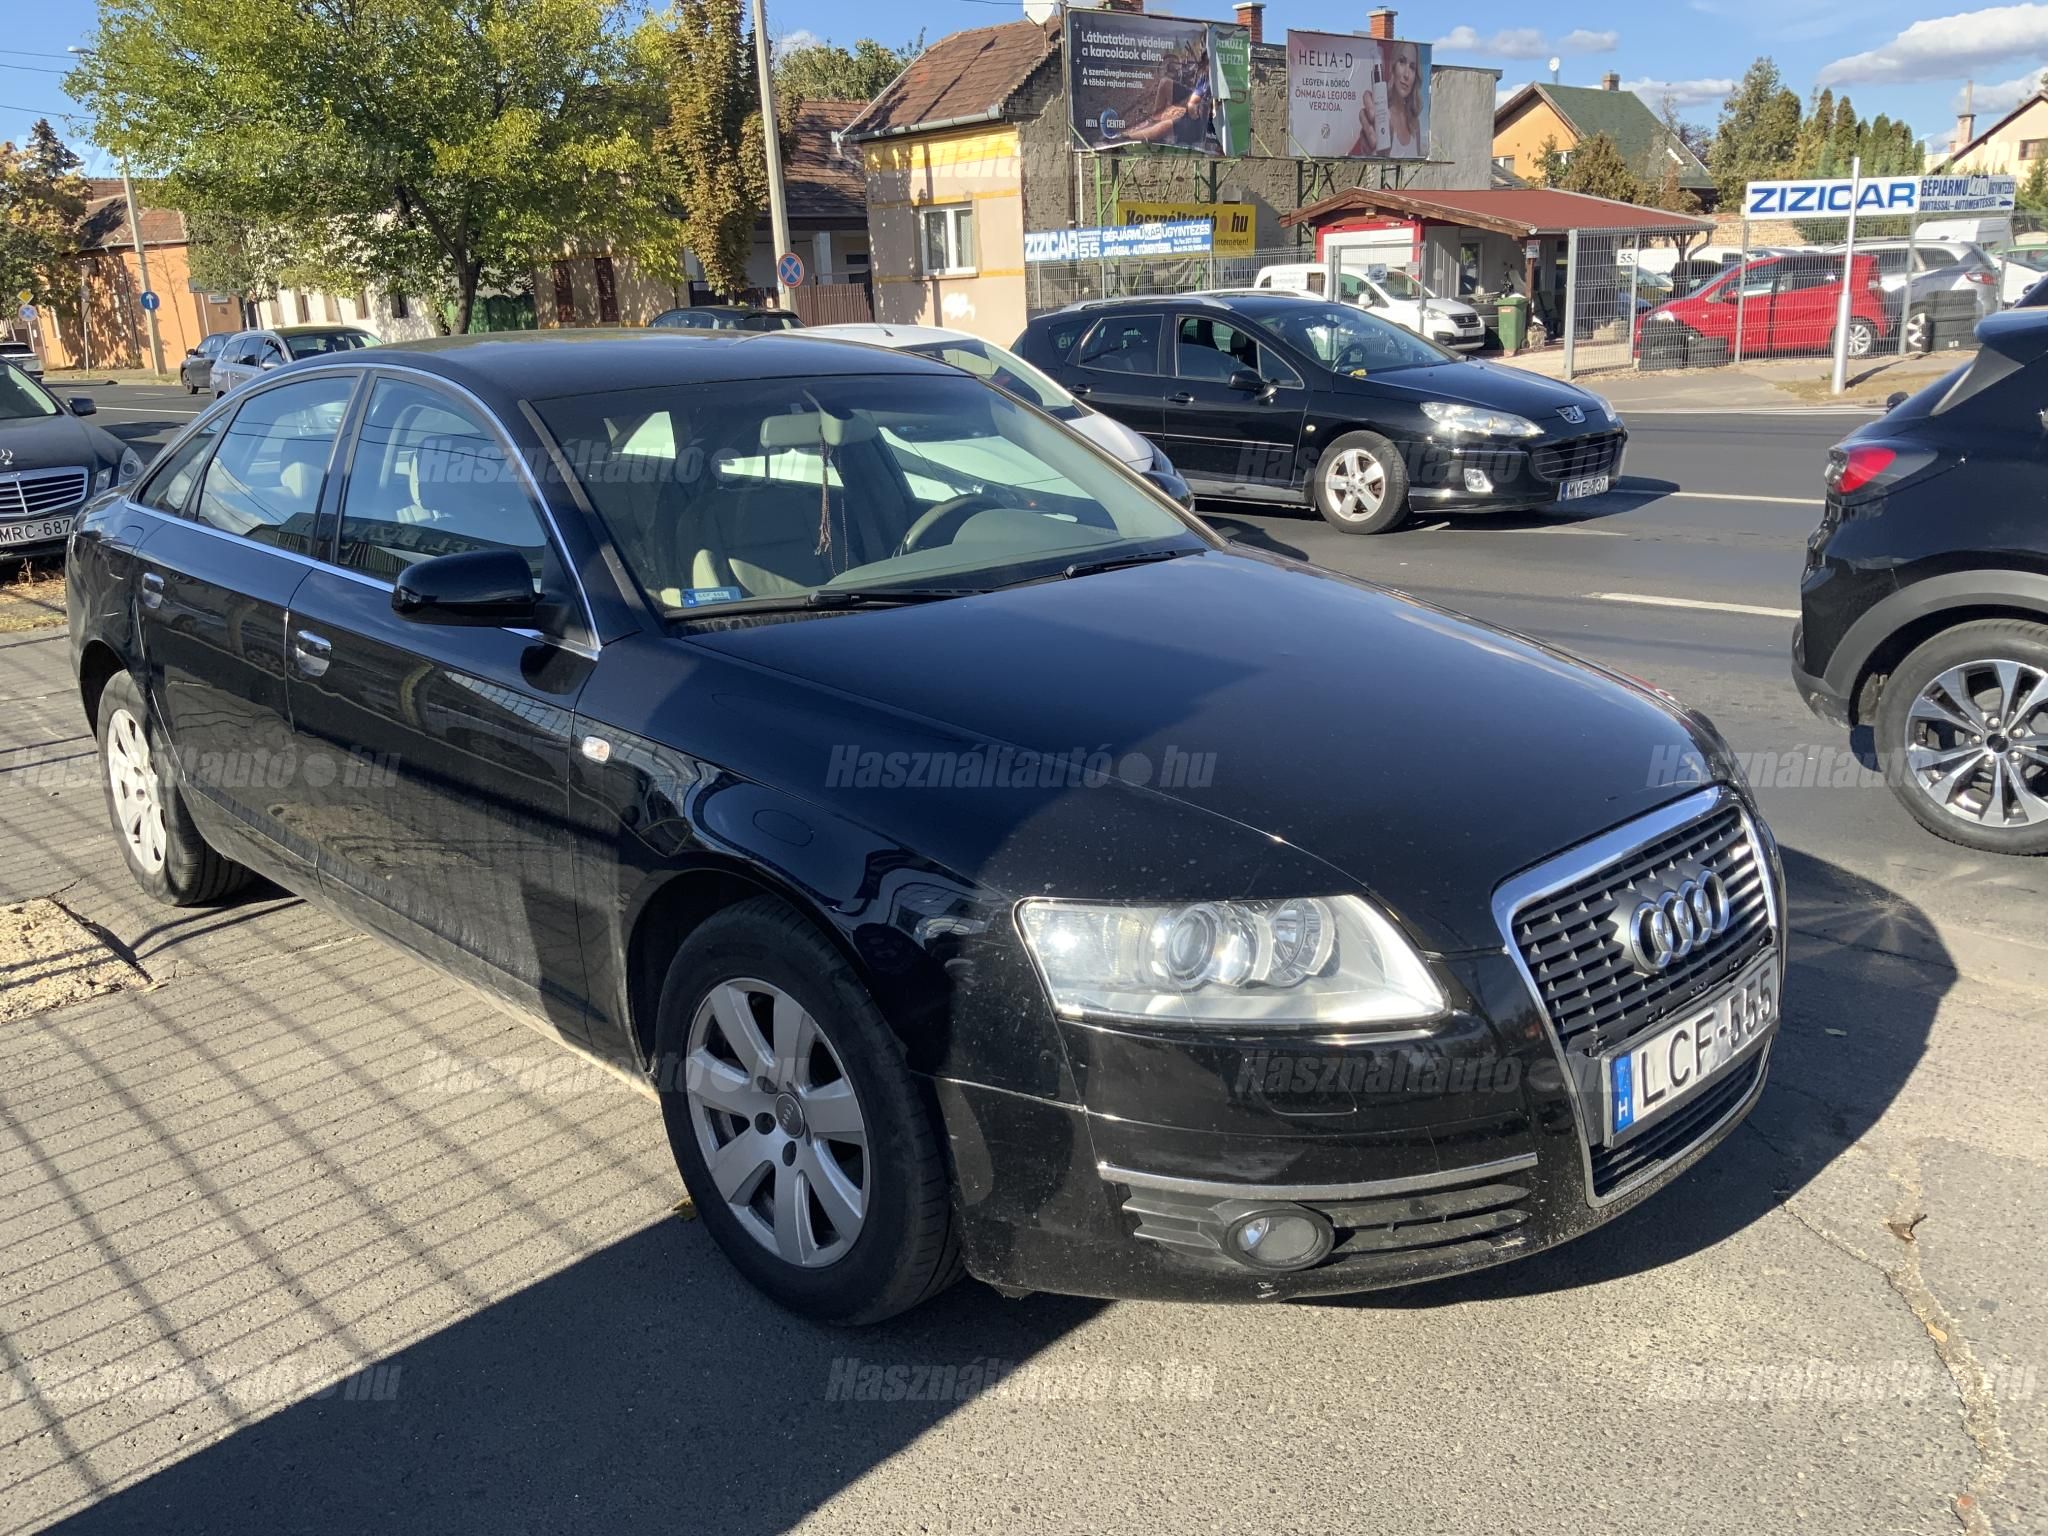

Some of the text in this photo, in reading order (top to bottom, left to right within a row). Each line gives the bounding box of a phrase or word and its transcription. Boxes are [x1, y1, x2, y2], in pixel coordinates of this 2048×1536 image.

[1081, 31, 1174, 49] Láthatatlan védelem
[1082, 45, 1164, 62] a karcolások ellen.
[1299, 50, 1353, 68] HELIA-D
[1082, 67, 1088, 76] A
[1082, 78, 1088, 86] A
[1089, 78, 1106, 87] többi
[1106, 80, 1126, 89] rajtad
[1302, 78, 1325, 87] LEGYEN
[1327, 90, 1356, 100] LEGJOBB
[1085, 118, 1126, 129] HOYA CENTER
[1750, 182, 1915, 213] ZIZICAR
[1162, 221, 1210, 237] ÜGYINTÉZÉS
[1025, 231, 1078, 262] ZIZICAR
[0, 519, 71, 542] MRC-687
[1640, 967, 1772, 1108] LCF-555
[1617, 1096, 1628, 1121] H
